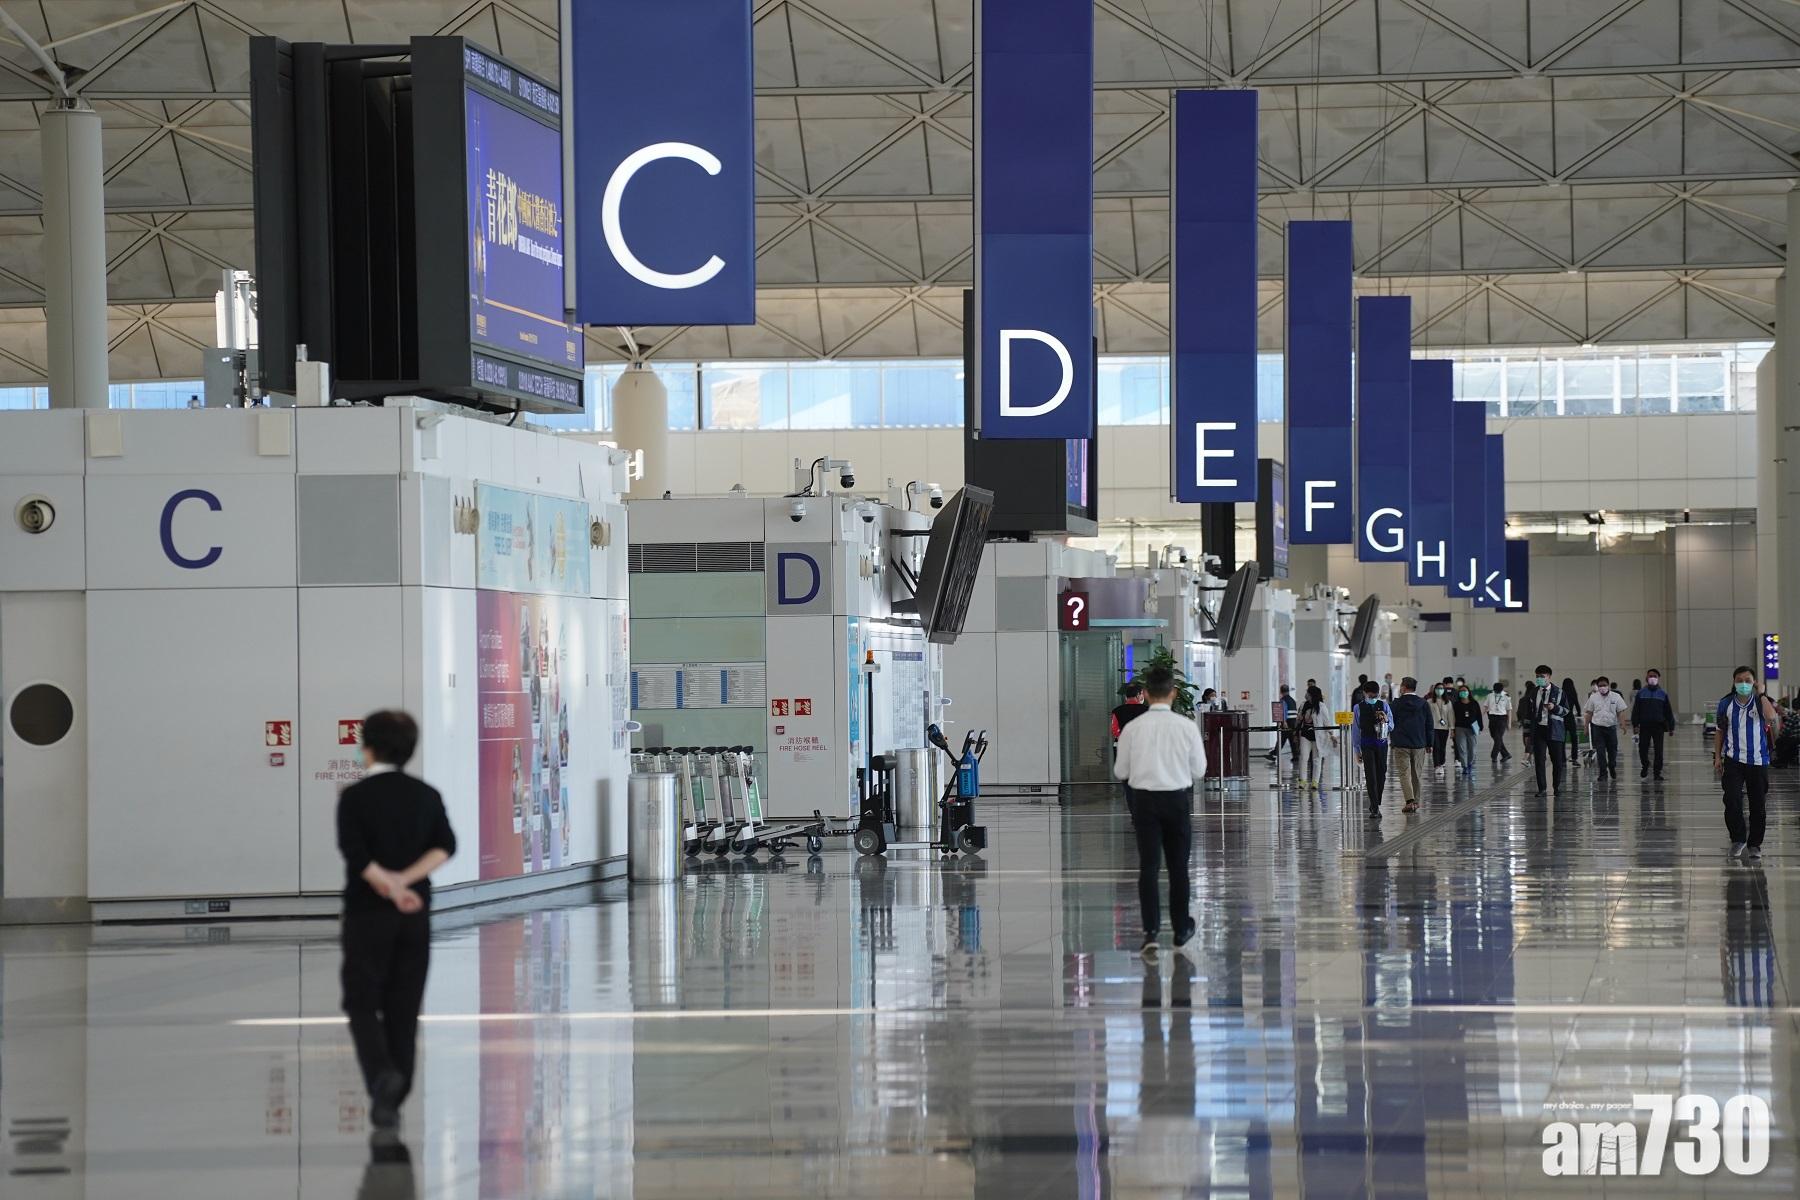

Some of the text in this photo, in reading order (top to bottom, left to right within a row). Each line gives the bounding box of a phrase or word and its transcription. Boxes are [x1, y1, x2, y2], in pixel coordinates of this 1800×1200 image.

[486, 168, 517, 249] 青花郎
[602, 141, 726, 290] C
[998, 329, 1074, 418] D
[1195, 422, 1238, 487] E
[160, 489, 223, 569] C
[1304, 480, 1337, 532] F
[1365, 507, 1404, 553] G
[777, 552, 821, 605] D
[1416, 540, 1446, 578] H
[1458, 557, 1477, 592] J
[1504, 578, 1523, 608] L
[315, 771, 363, 780] FIRE HOSE
